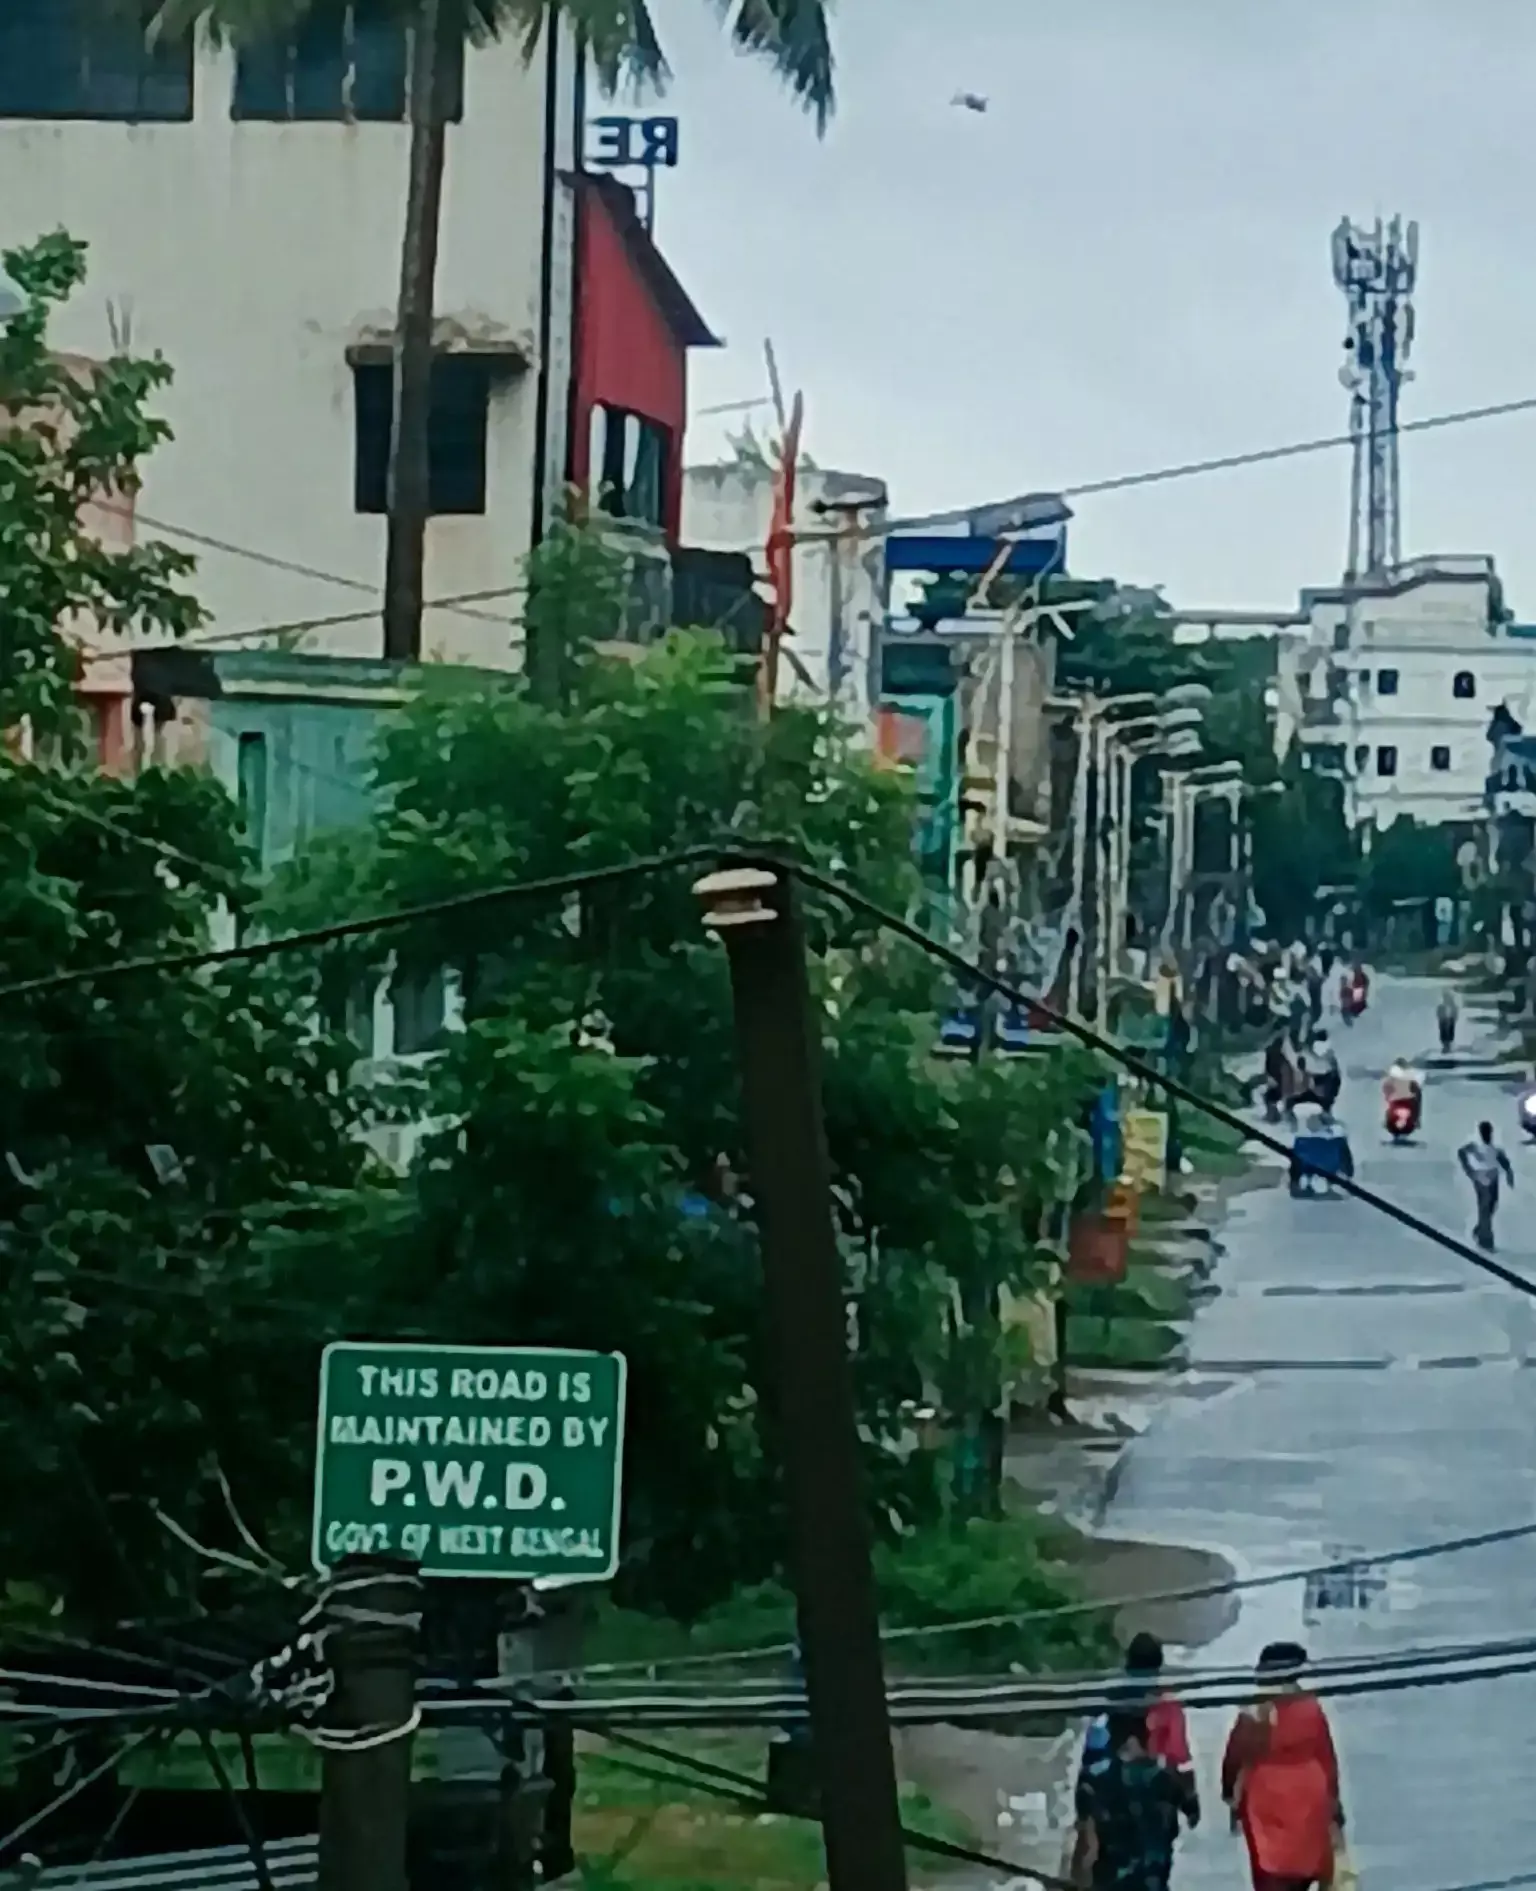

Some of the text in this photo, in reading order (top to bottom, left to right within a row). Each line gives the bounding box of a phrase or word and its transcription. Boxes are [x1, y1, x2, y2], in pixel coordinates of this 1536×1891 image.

[356, 1364, 592, 1402] THIS ROAD IS
[330, 1415, 609, 1447] MAINTAINED BY
[370, 1458, 567, 1511] P.W.D.
[401, 1523, 432, 1558] OF
[439, 1524, 503, 1554] WEST
[509, 1526, 605, 1557] BENGAL
